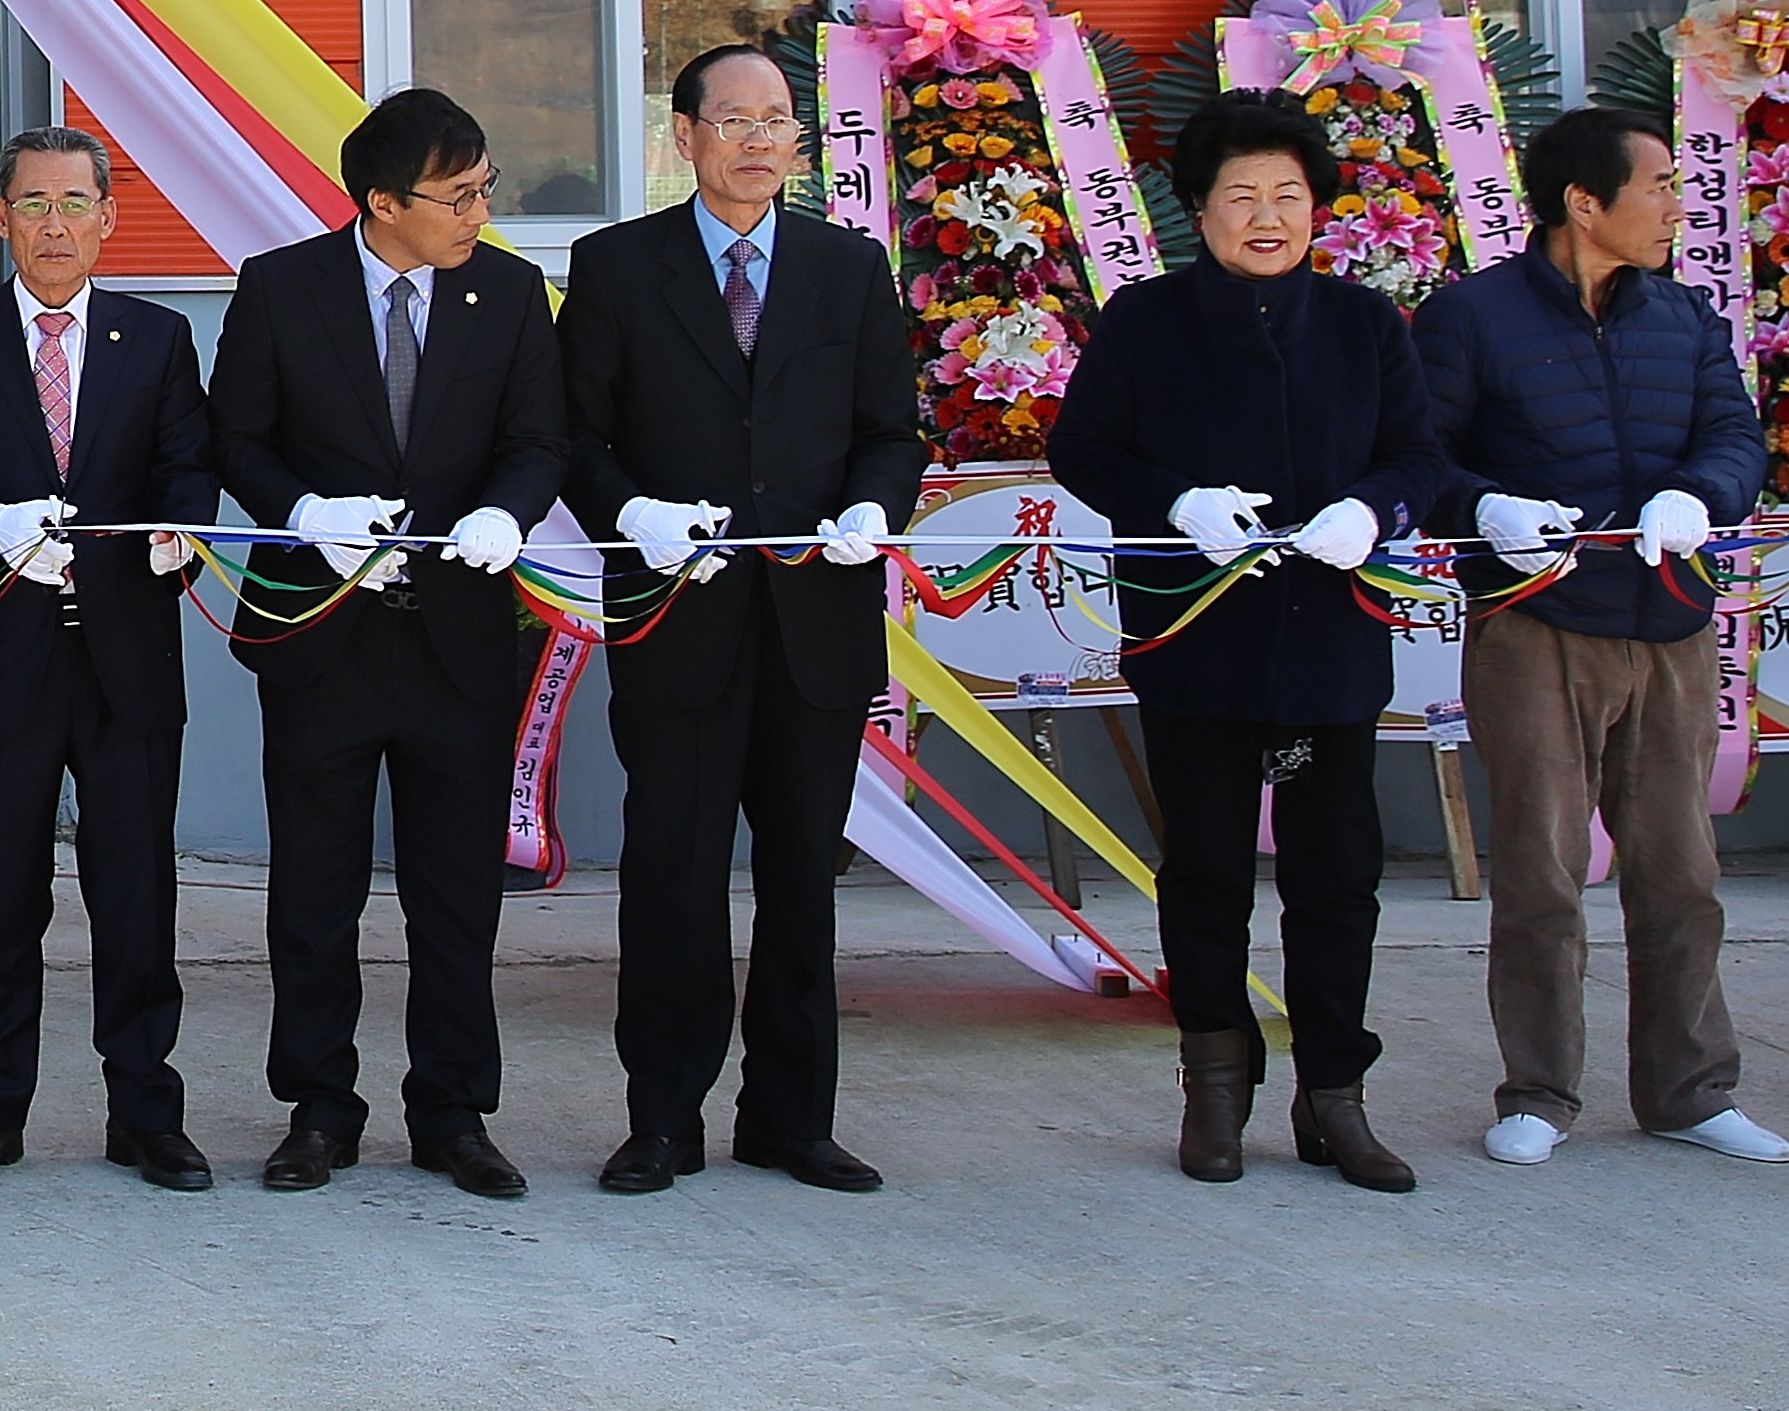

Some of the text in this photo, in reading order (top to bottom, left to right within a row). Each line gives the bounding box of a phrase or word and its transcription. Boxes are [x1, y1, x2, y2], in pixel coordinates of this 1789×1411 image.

[1059, 100, 1106, 131] 축
[1446, 102, 1494, 135] 축
[512, 757, 537, 837] 김인규
